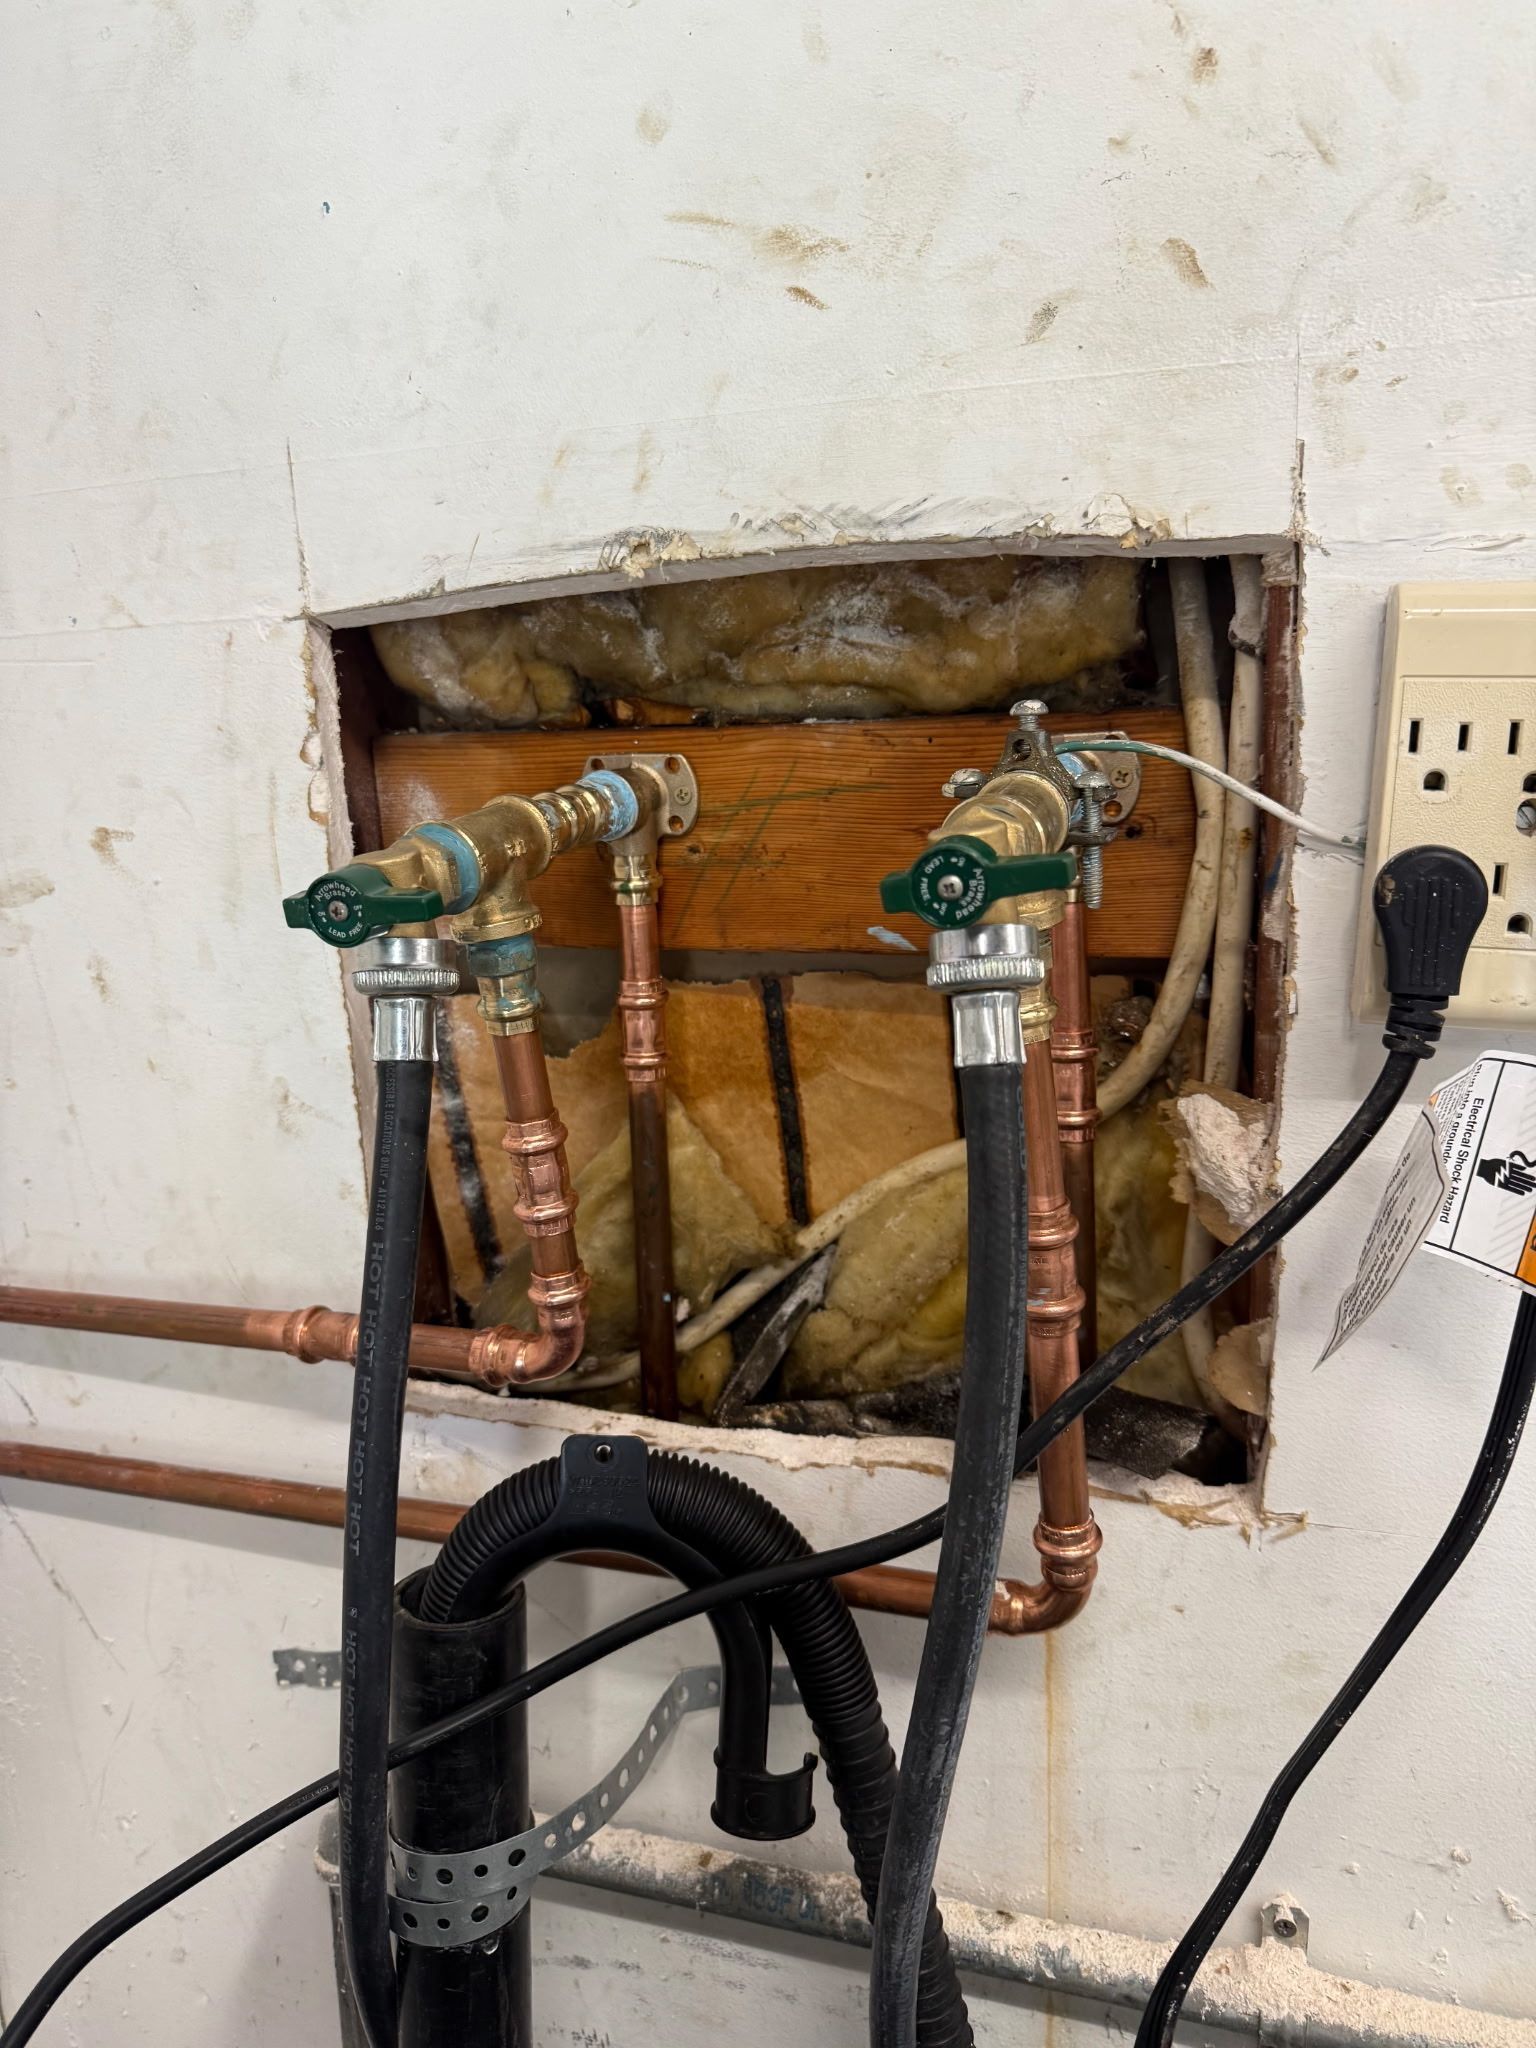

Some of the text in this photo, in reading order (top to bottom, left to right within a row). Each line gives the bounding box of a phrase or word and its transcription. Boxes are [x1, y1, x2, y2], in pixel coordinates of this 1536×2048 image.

[314, 880, 357, 902] Arrowhead
[324, 890, 346, 900] Brass
[920, 855, 944, 900] LEAD FREE
[954, 868, 985, 920] Arrowhead
[959, 880, 978, 907] Brass
[328, 921, 363, 938] LEAD FREE
[381, 1111, 394, 1155] LOCATIONS
[1439, 1097, 1485, 1224] Electrical Shock Hazard
[1388, 1213, 1407, 1253] causer
[1407, 1196, 1416, 1214] un
[368, 1242, 384, 1300] HOT
[1370, 1253, 1395, 1300] incendie
[1395, 1236, 1403, 1252] ou
[1403, 1219, 1412, 1236] un
[362, 1309, 378, 1368] HOT
[357, 1375, 371, 1432] HOT
[352, 1439, 366, 1496] HOT
[350, 1502, 362, 1557] HOT
[346, 1630, 357, 1680] HOT
[344, 1684, 355, 1732] HOT
[343, 1735, 354, 1780] HOT
